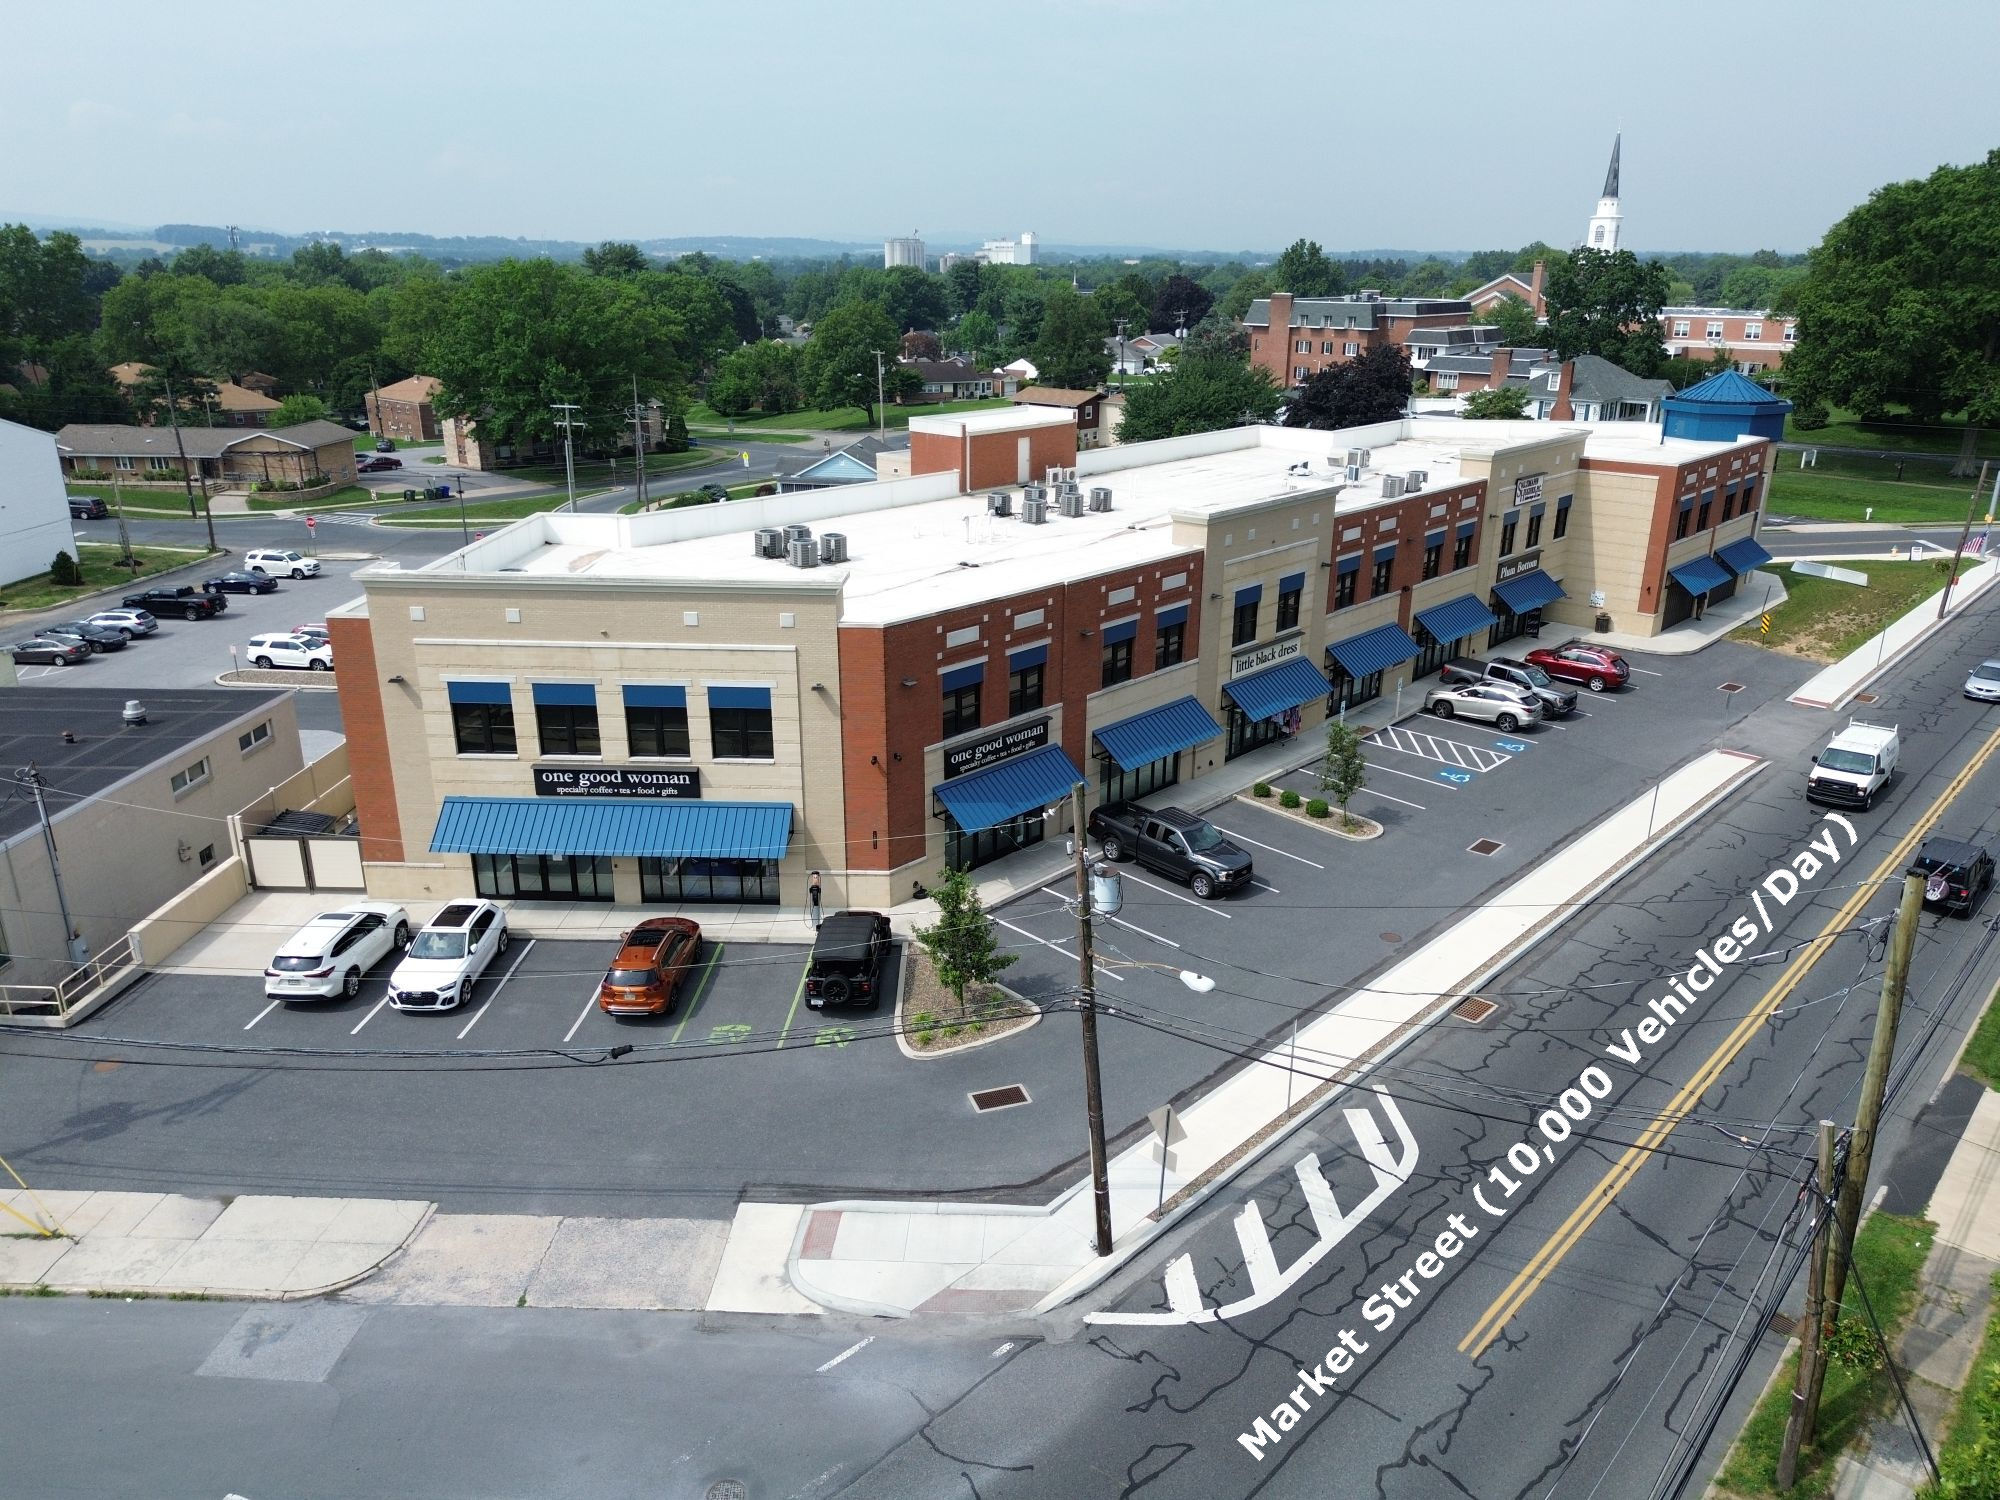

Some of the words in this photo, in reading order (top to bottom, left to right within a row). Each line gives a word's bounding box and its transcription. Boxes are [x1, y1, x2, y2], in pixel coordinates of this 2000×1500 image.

[1501, 566, 1516, 578] Plum
[1517, 560, 1537, 573] Bottom
[1236, 656, 1254, 673] little
[1256, 648, 1276, 666] black
[1278, 643, 1298, 657] dress
[950, 749, 973, 764] one
[975, 736, 1003, 760] good
[1005, 725, 1044, 745] woman
[959, 761, 981, 773] specialty
[981, 754, 997, 764] coffee
[1011, 743, 1023, 754] food
[1025, 740, 1036, 751] gifts
[542, 771, 574, 783] one
[579, 769, 623, 787] good
[627, 772, 691, 785] woman
[556, 785, 589, 796] specialty
[589, 785, 614, 795] coffee
[619, 787, 631, 795] tea
[637, 786, 656, 795] food
[661, 787, 678, 797] gifts
